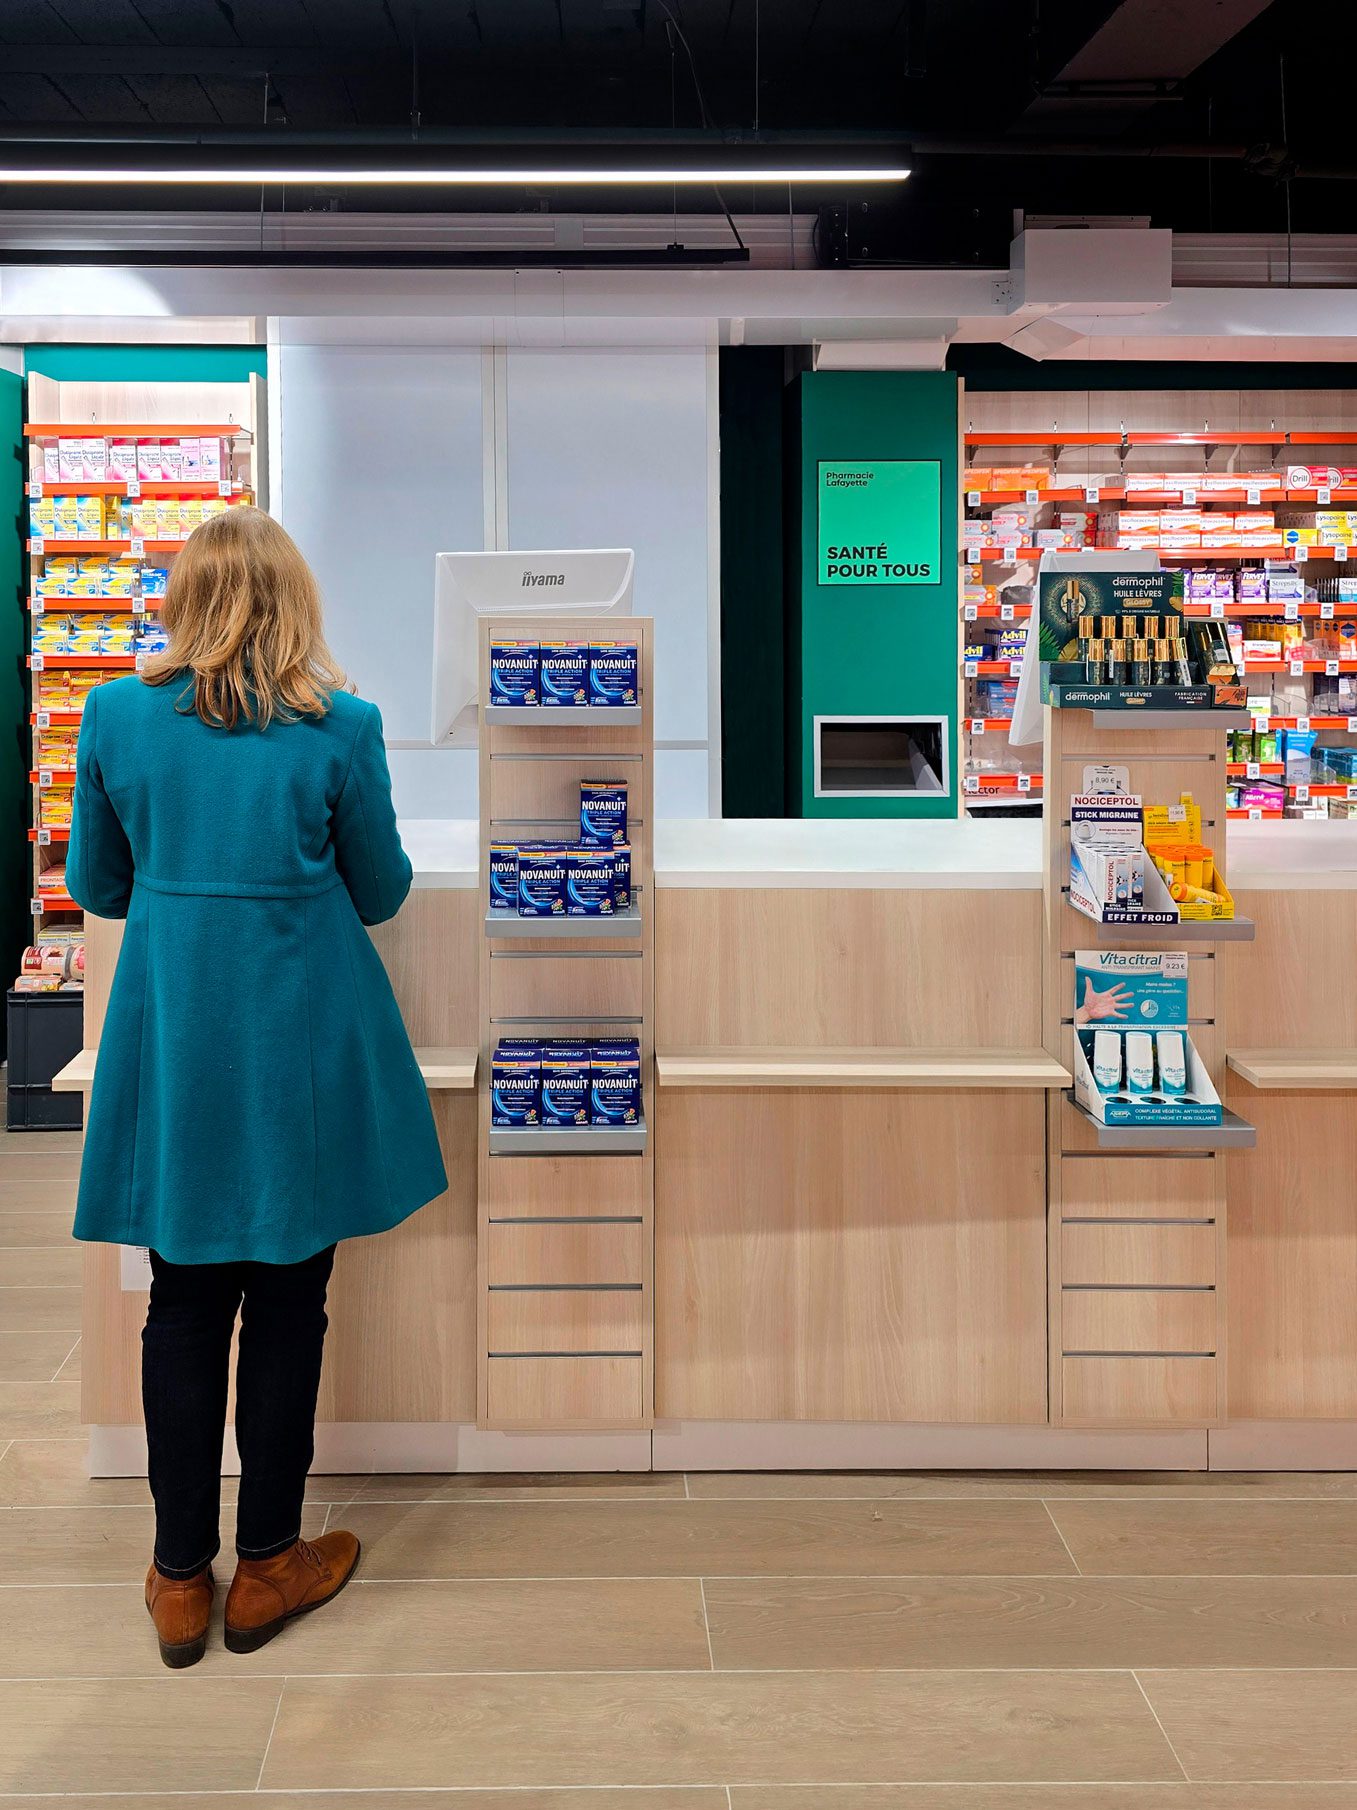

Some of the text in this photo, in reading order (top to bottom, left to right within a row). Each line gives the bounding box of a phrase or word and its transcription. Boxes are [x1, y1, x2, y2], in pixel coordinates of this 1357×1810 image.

[826, 480, 868, 488] Lafayette
[827, 543, 887, 559] SANTÉ
[827, 564, 930, 578] POUR TOUS
[522, 571, 565, 586] iiyama
[1112, 577, 1163, 589] dermophil
[1136, 589, 1162, 597] LÈVRES
[1001, 630, 1026, 640] Advil
[493, 659, 538, 669] NOVANUIT
[542, 659, 587, 669] NOVANUIT
[591, 659, 636, 669] NOVANUIT
[1065, 692, 1110, 703] dermophil
[582, 801, 626, 811] NOVANUIT
[1075, 797, 1139, 806] NOCICEPTOL
[520, 870, 565, 879] NOVANUIT
[569, 869, 613, 879] NOVANUIT
[1108, 913, 1173, 921] EFFET FROID
[494, 1079, 539, 1089] NOVANUIT
[543, 1079, 588, 1089] NOVANUIT
[592, 1079, 637, 1089] NOVANUIT
